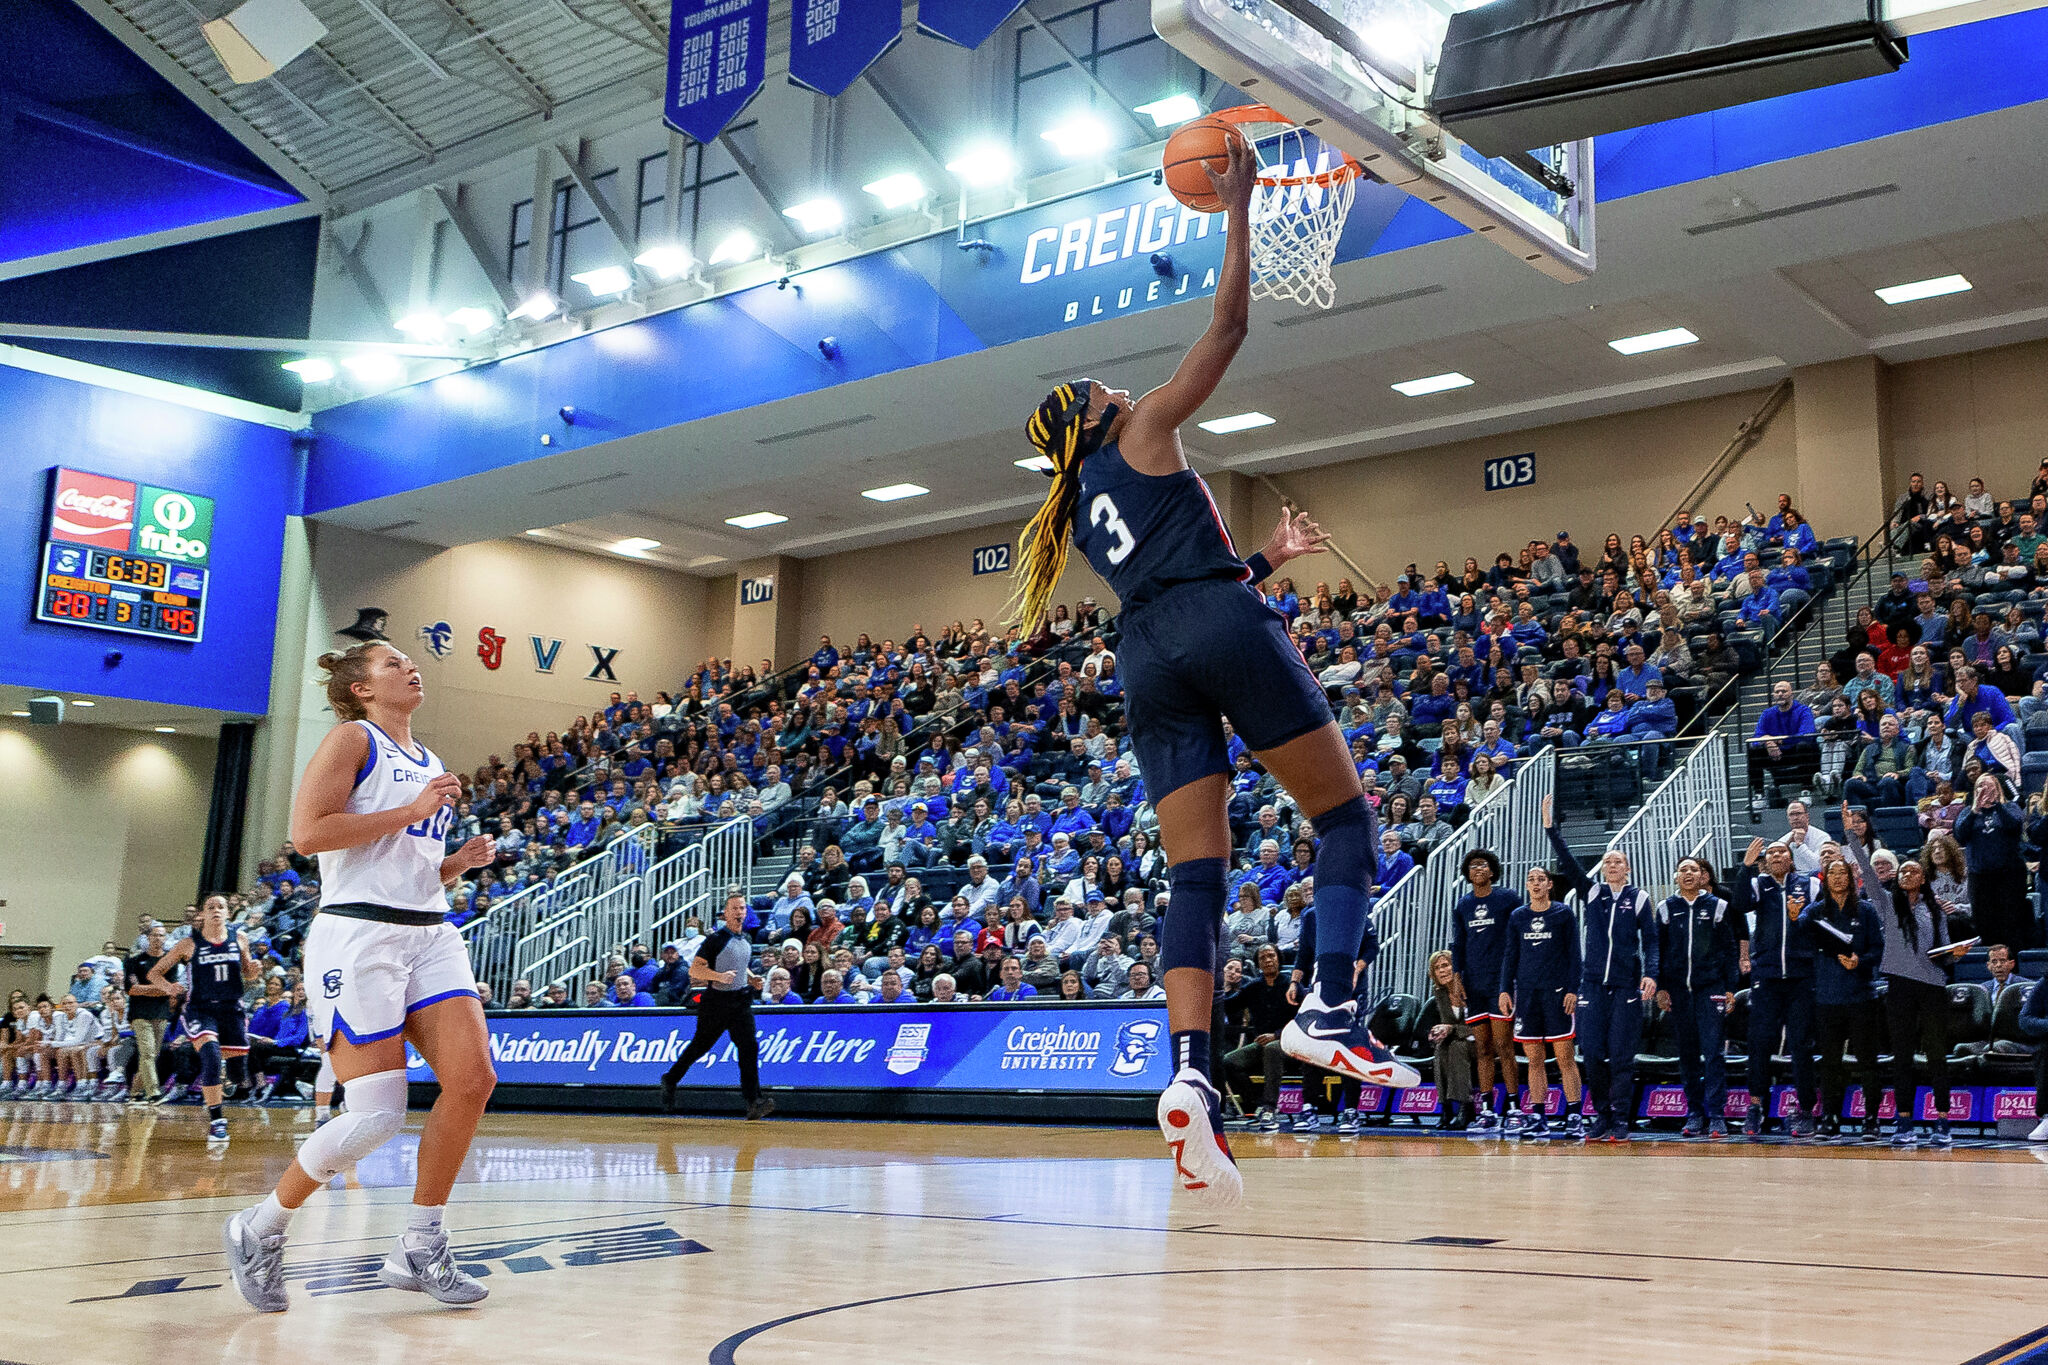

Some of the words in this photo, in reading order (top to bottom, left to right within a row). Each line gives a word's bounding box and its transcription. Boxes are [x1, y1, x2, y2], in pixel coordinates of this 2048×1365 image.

[806, 0, 839, 28] 2020
[683, 30, 713, 55] 2010
[720, 17, 750, 42] 2015
[808, 18, 836, 45] 2021
[682, 48, 712, 73] 2012
[719, 34, 748, 60] 2016
[680, 66, 710, 90] 2013
[717, 52, 747, 77] 2017
[678, 83, 708, 108] 2014
[716, 70, 746, 95] 2018
[1487, 456, 1533, 487] 103
[56, 487, 134, 521] Coca-Cola
[139, 525, 208, 558] fnbo
[1089, 493, 1136, 565] 3
[106, 556, 165, 587] 6:33
[975, 546, 1008, 573] 102
[53, 590, 90, 619] 28
[744, 580, 772, 602] 101
[116, 602, 131, 622] 3
[162, 608, 195, 634] 45
[213, 964, 229, 982] 11
[489, 1029, 609, 1072] Nationally
[798, 1030, 876, 1064] Here
[1006, 1023, 1101, 1057] Creighton
[1001, 1056, 1097, 1070] UNIVERSITY
[1654, 1094, 1683, 1105] IDEAL
[2001, 1096, 2035, 1109] IDEAL
